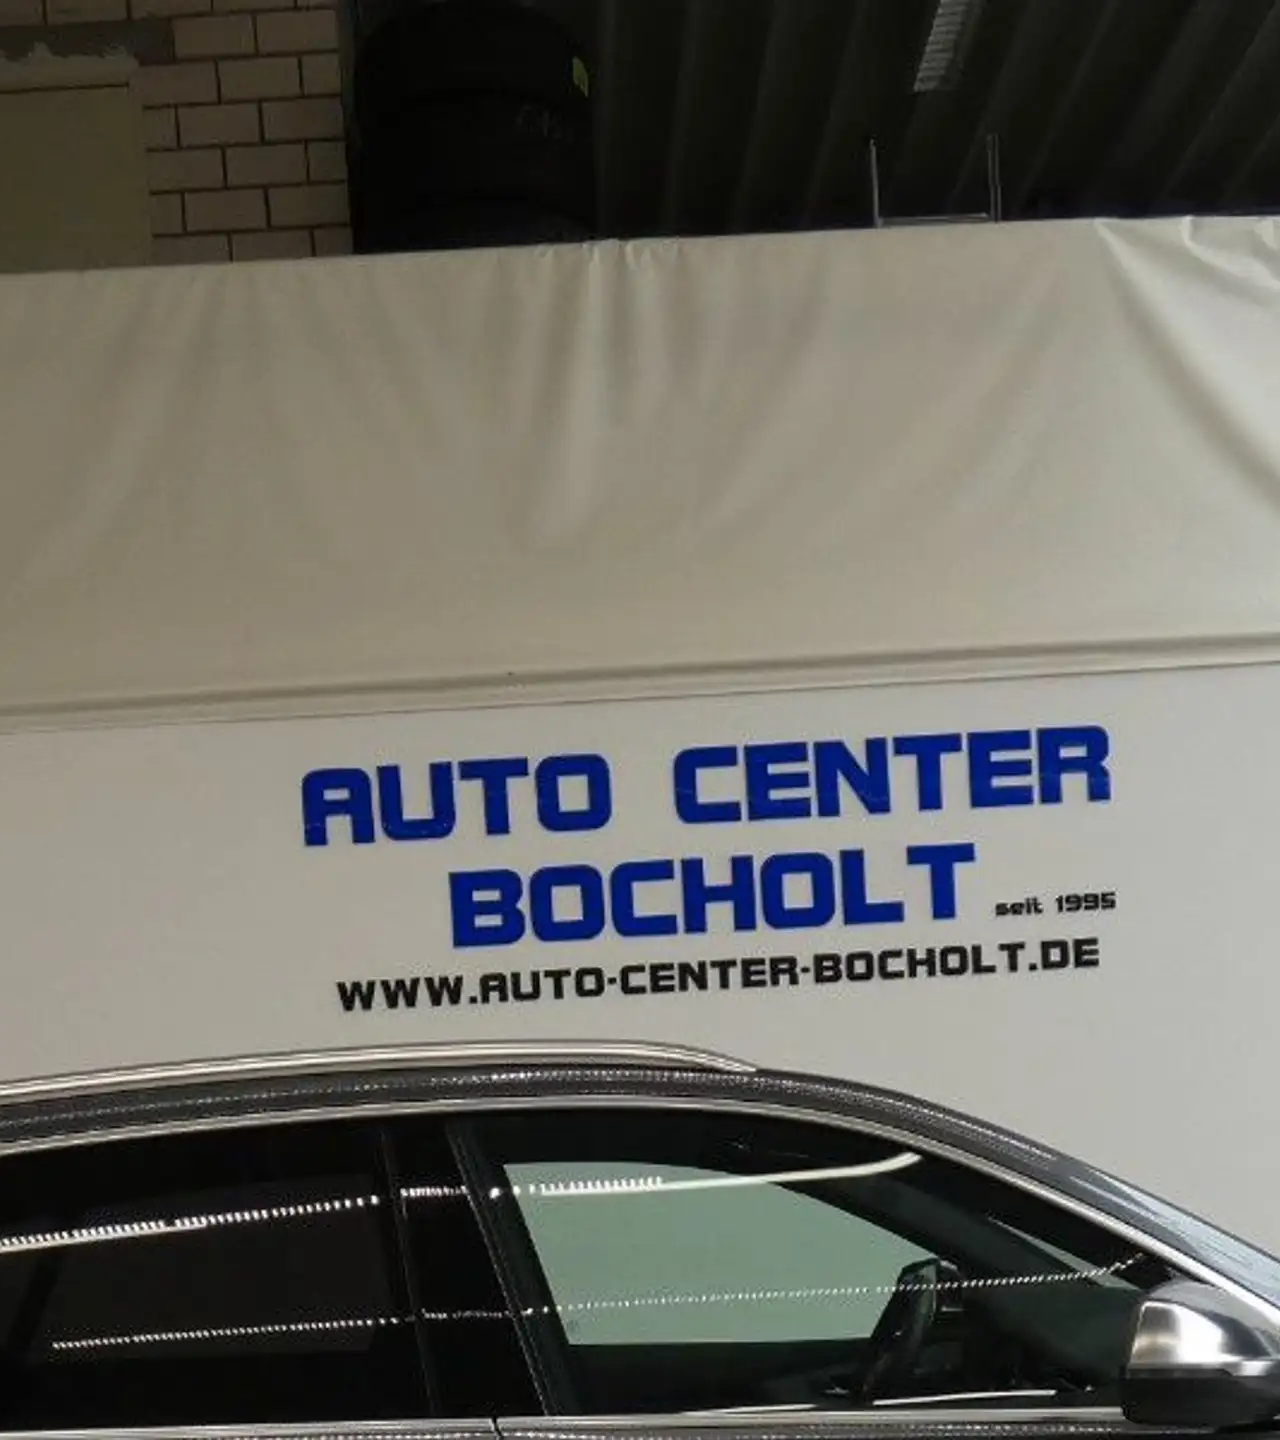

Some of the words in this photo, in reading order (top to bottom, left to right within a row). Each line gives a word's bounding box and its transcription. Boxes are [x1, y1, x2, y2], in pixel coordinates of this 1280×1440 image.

[302, 754, 612, 846] AUTO
[673, 725, 1111, 824] CENTER
[449, 843, 977, 948] BOCHOLT
[995, 896, 1044, 917] seit
[1054, 891, 1116, 913] 1995
[336, 937, 1100, 1012] WWW.AUTO-CENTER-BOCHOLT.DE
